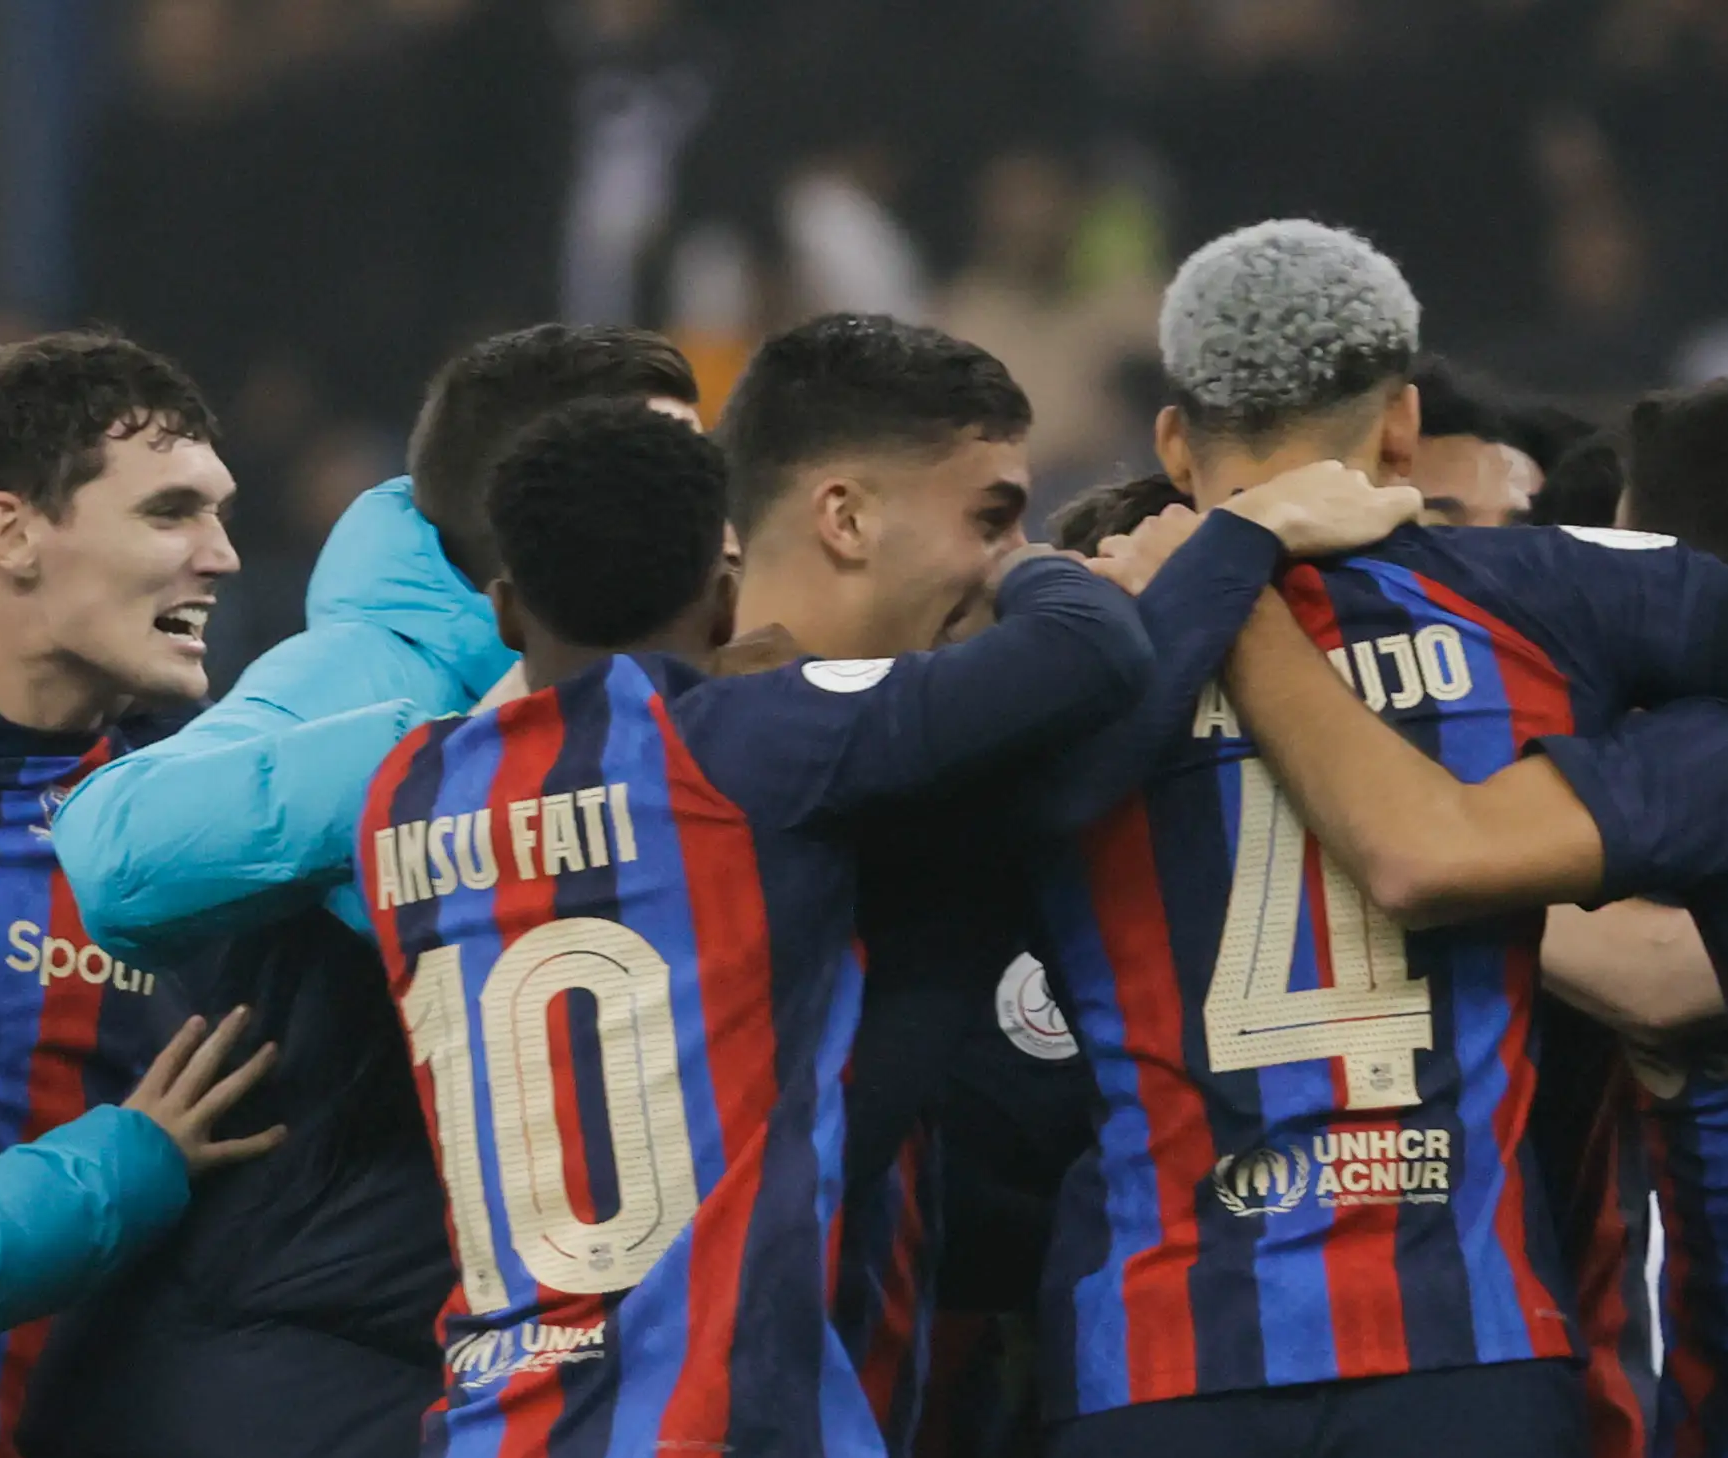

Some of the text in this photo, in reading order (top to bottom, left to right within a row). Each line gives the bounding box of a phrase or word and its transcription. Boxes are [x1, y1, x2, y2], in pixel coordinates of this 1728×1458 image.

[1192, 625, 1472, 738] AUJO
[375, 783, 637, 910] ANSU FATI
[1204, 759, 1432, 1108] 4
[402, 917, 699, 1316] 10
[1313, 1129, 1451, 1163] UNHCR
[1317, 1161, 1449, 1196] ACNUR
